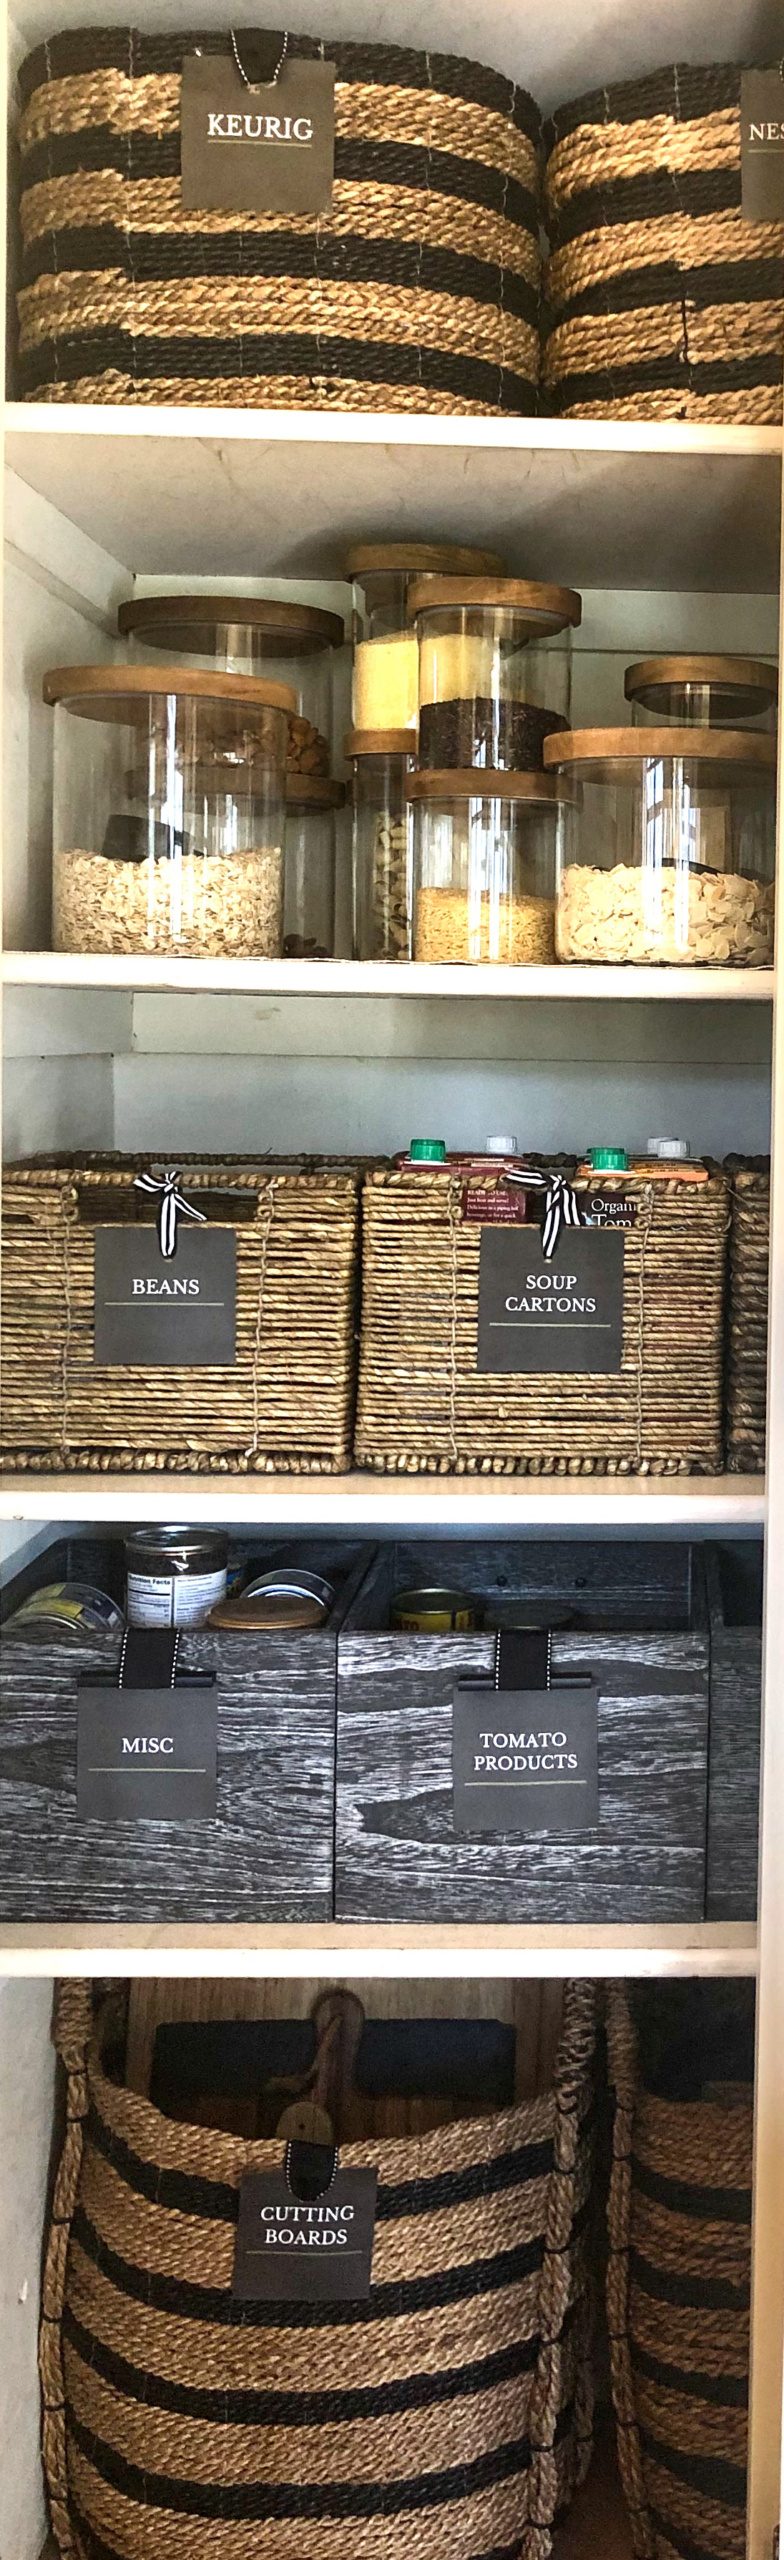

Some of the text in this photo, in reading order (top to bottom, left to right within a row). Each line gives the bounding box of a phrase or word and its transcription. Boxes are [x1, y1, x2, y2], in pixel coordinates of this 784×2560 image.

[207, 113, 313, 140] KEURIG
[131, 1279, 200, 1295] BEANS
[525, 1275, 577, 1290] SOUP
[505, 1296, 597, 1312] CARTONS
[121, 1737, 174, 1753] MISC
[479, 1732, 567, 1748] TOMATO
[474, 1754, 578, 1771] PRODUCTS
[260, 2205, 355, 2222] CUTTING
[264, 2228, 348, 2245] BOARDS
